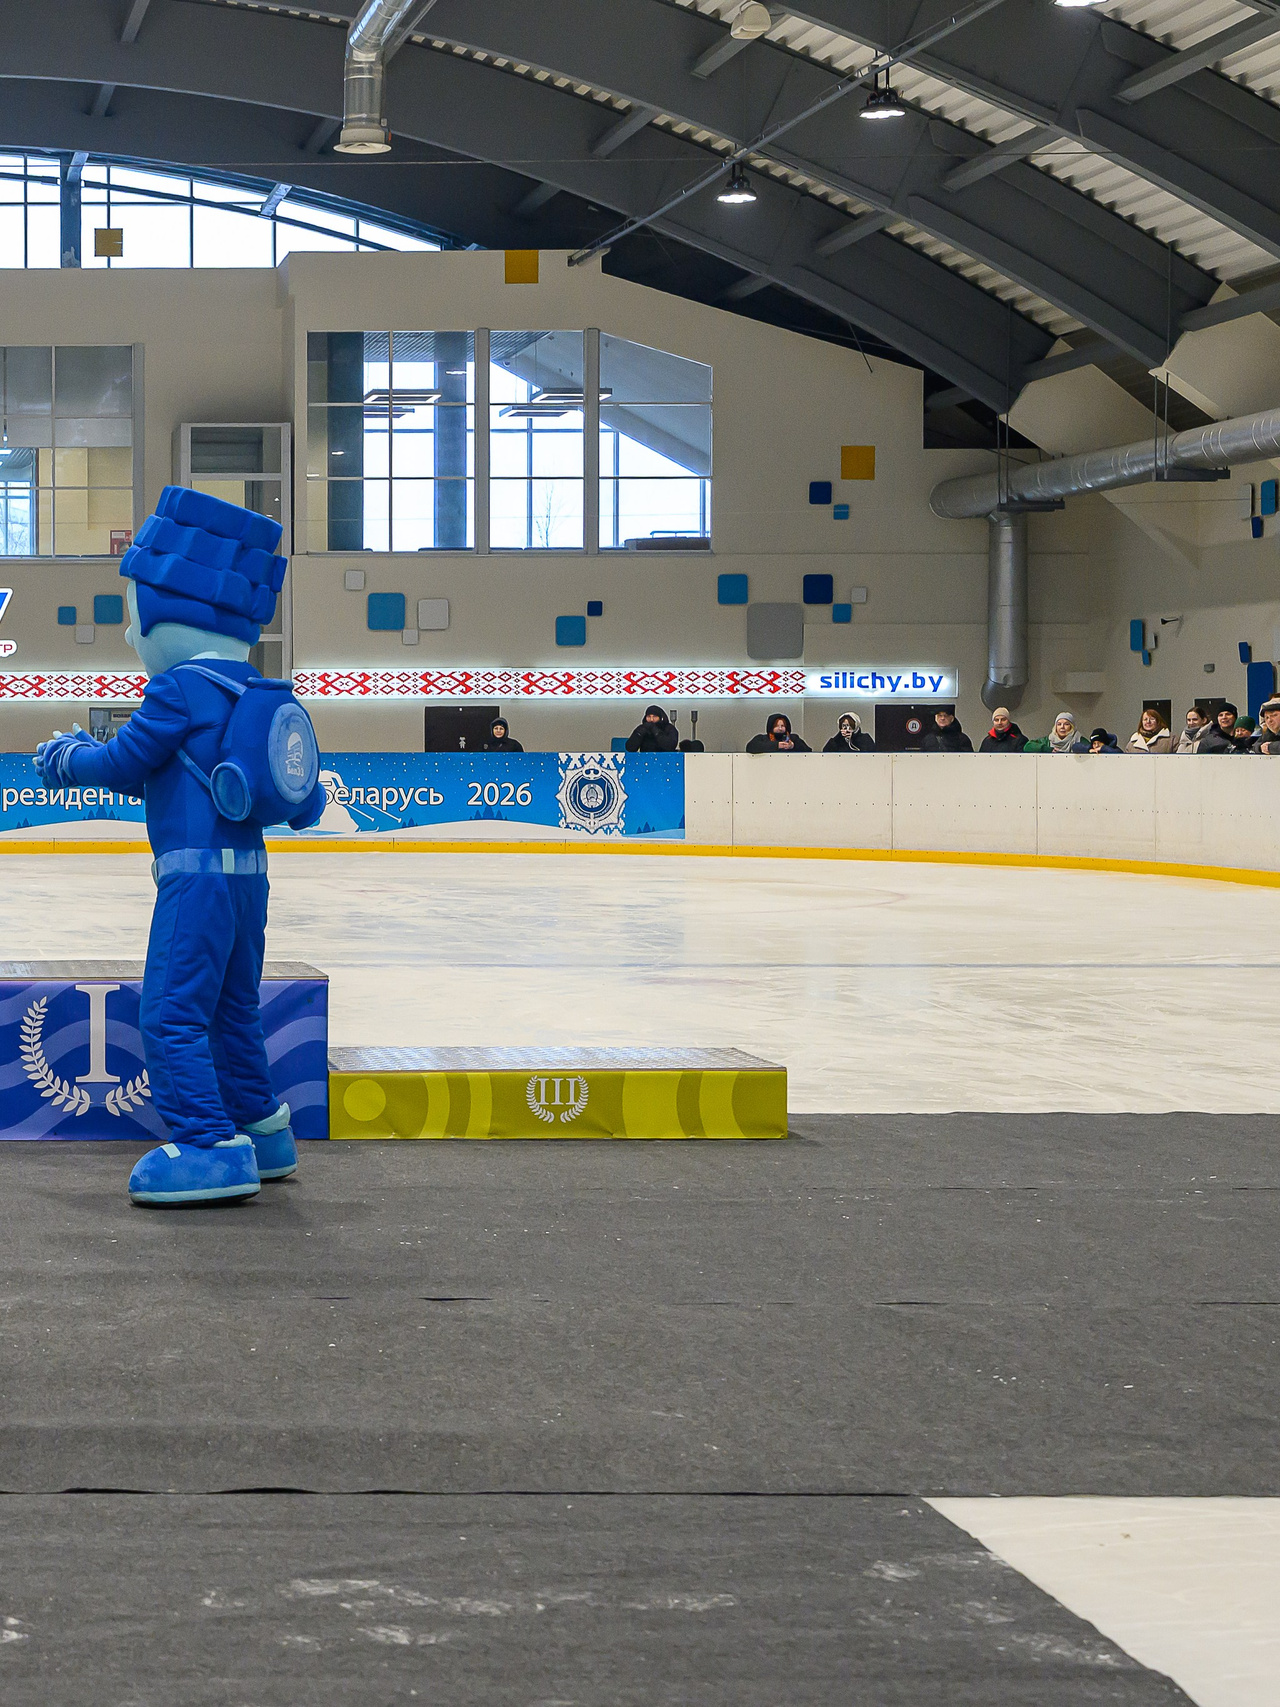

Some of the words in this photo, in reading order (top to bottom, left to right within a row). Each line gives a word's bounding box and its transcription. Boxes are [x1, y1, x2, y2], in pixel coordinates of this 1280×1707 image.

[819, 671, 944, 693] silichy.by
[466, 781, 534, 807] 2026
[74, 983, 121, 1083] I
[536, 1077, 580, 1106] III
